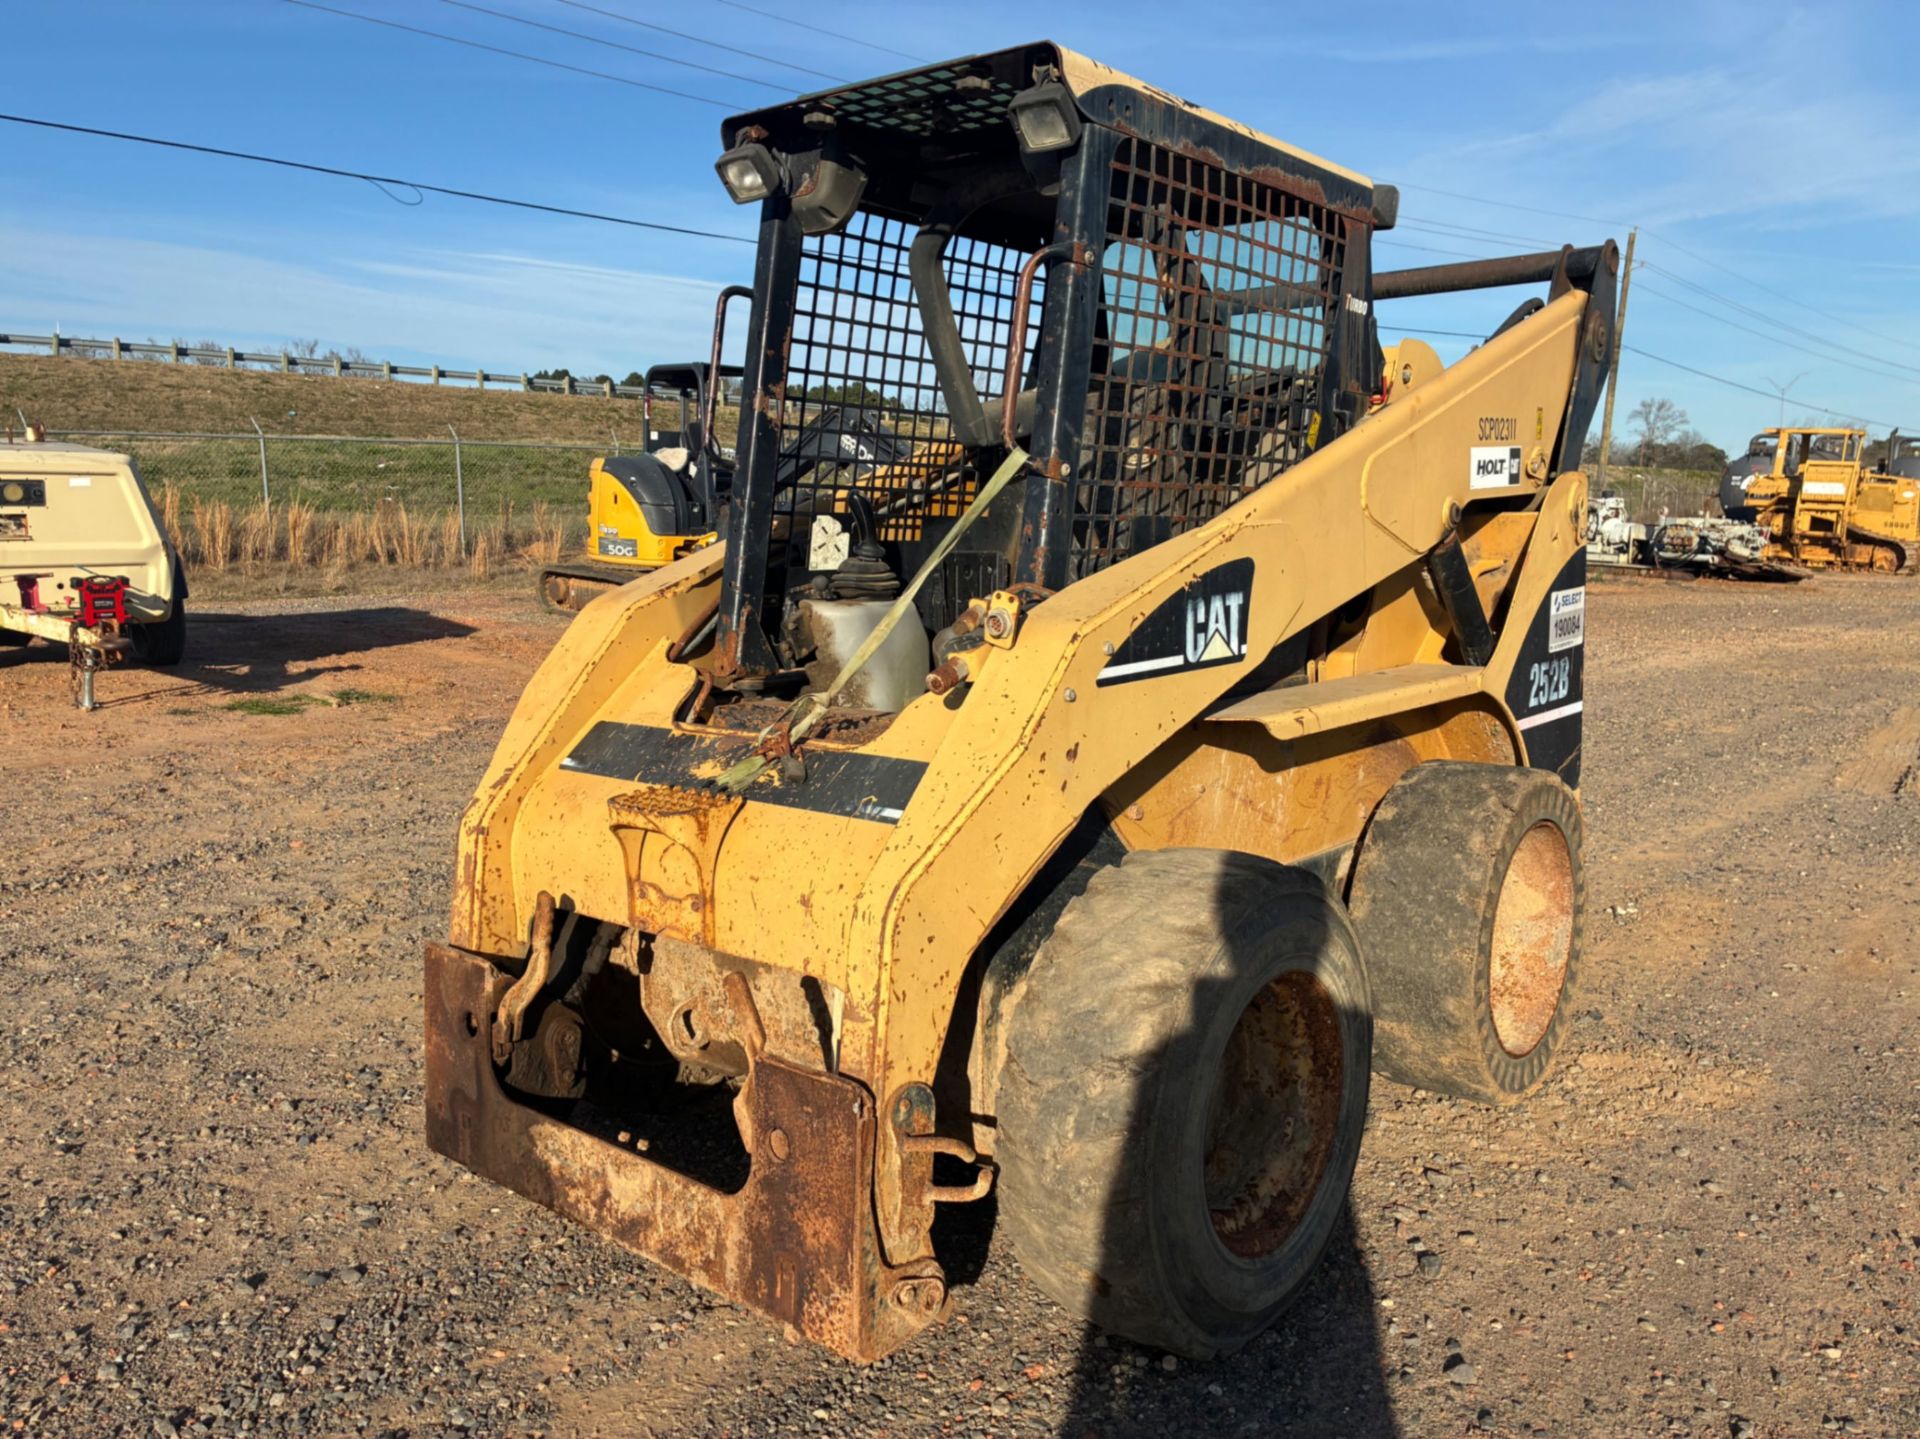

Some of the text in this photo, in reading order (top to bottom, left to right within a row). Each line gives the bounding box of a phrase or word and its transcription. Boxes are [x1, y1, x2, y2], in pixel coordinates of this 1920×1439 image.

[1478, 417, 1517, 441] SCP02311
[1476, 459, 1506, 475] HOLT
[608, 544, 634, 558] 50G
[1562, 591, 1582, 607] SELECT
[1186, 592, 1243, 663] CAT
[1529, 656, 1570, 708] 252B
